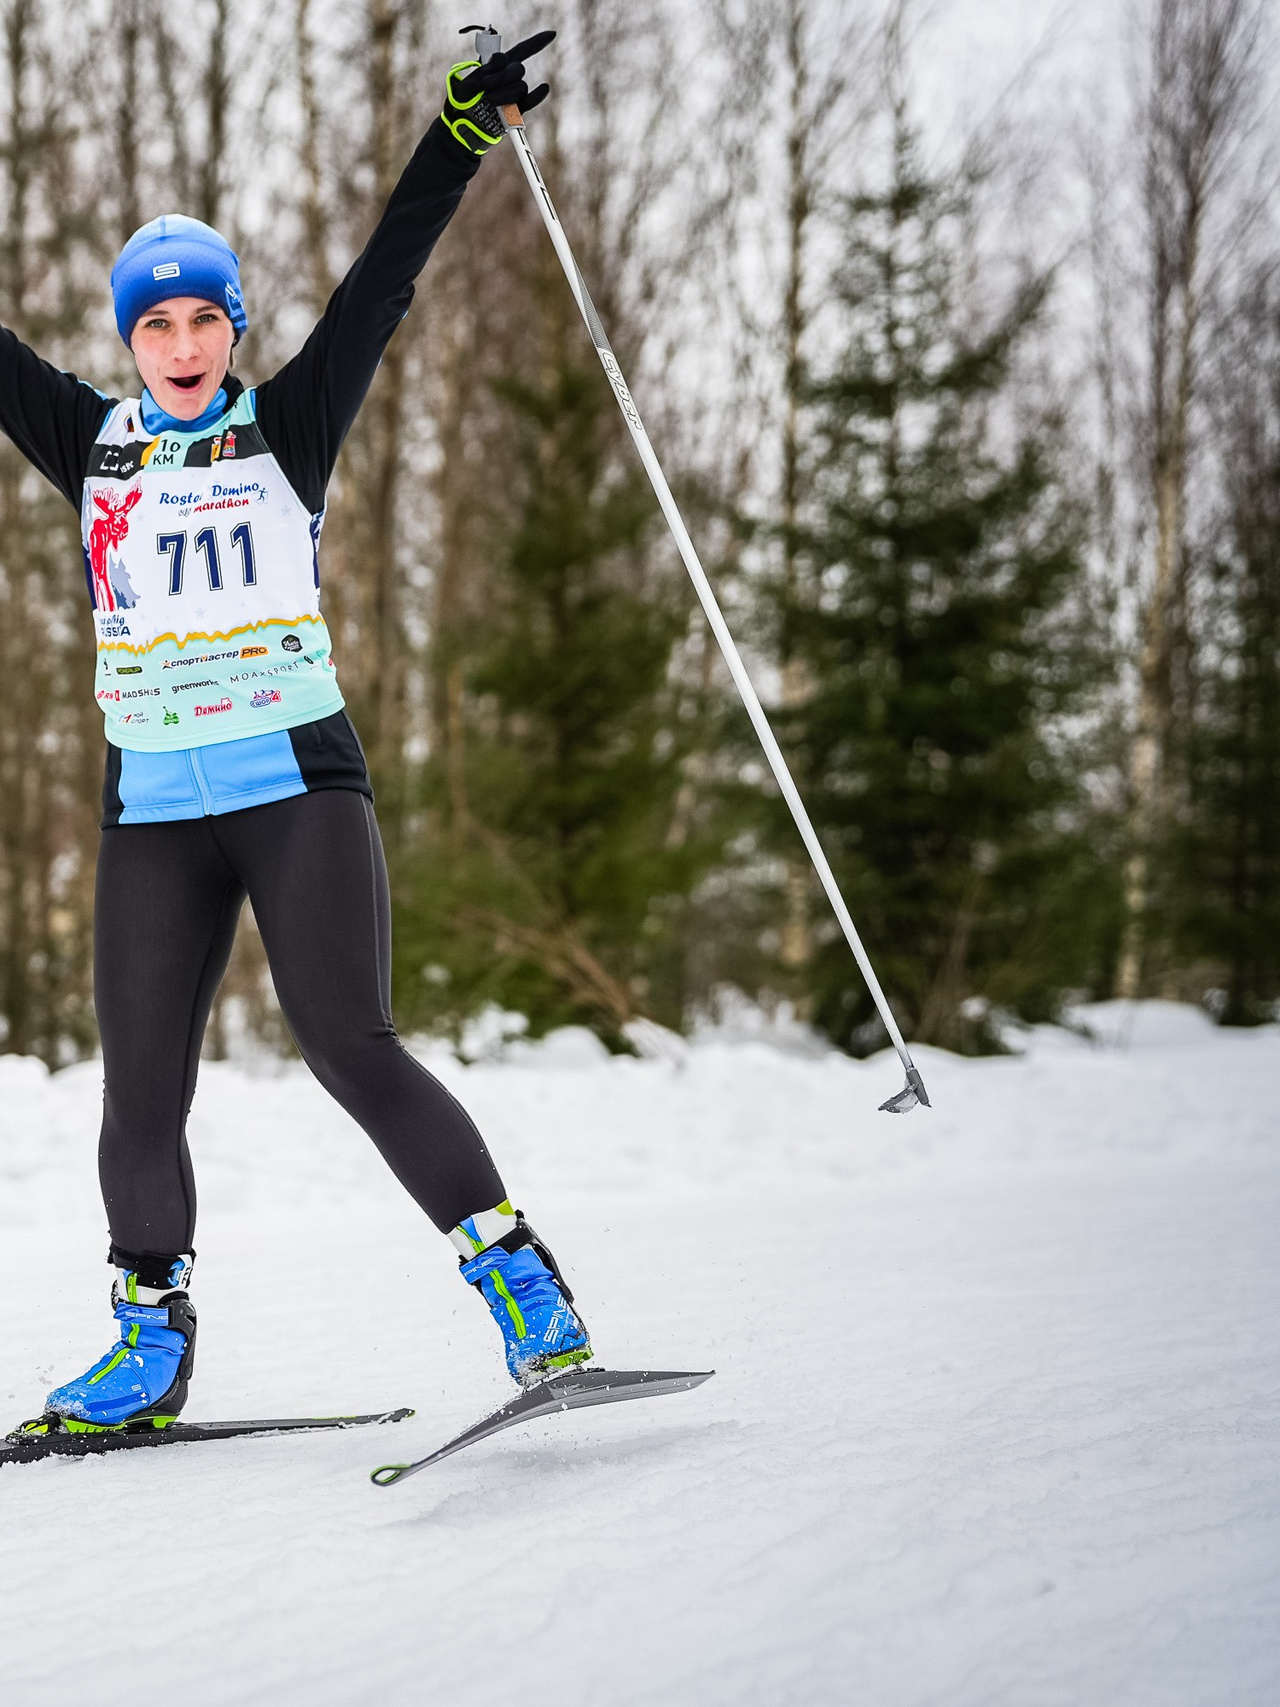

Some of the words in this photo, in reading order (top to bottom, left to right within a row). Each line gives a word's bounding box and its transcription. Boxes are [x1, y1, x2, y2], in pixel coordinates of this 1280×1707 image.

[161, 439, 181, 453] 10
[153, 454, 174, 465] KM
[212, 482, 260, 497] Demino
[193, 498, 250, 514] marathon
[157, 521, 257, 596] 711
[241, 646, 268, 658] PRO
[125, 1311, 167, 1320] SPINE
[543, 1294, 567, 1344] SPINE
